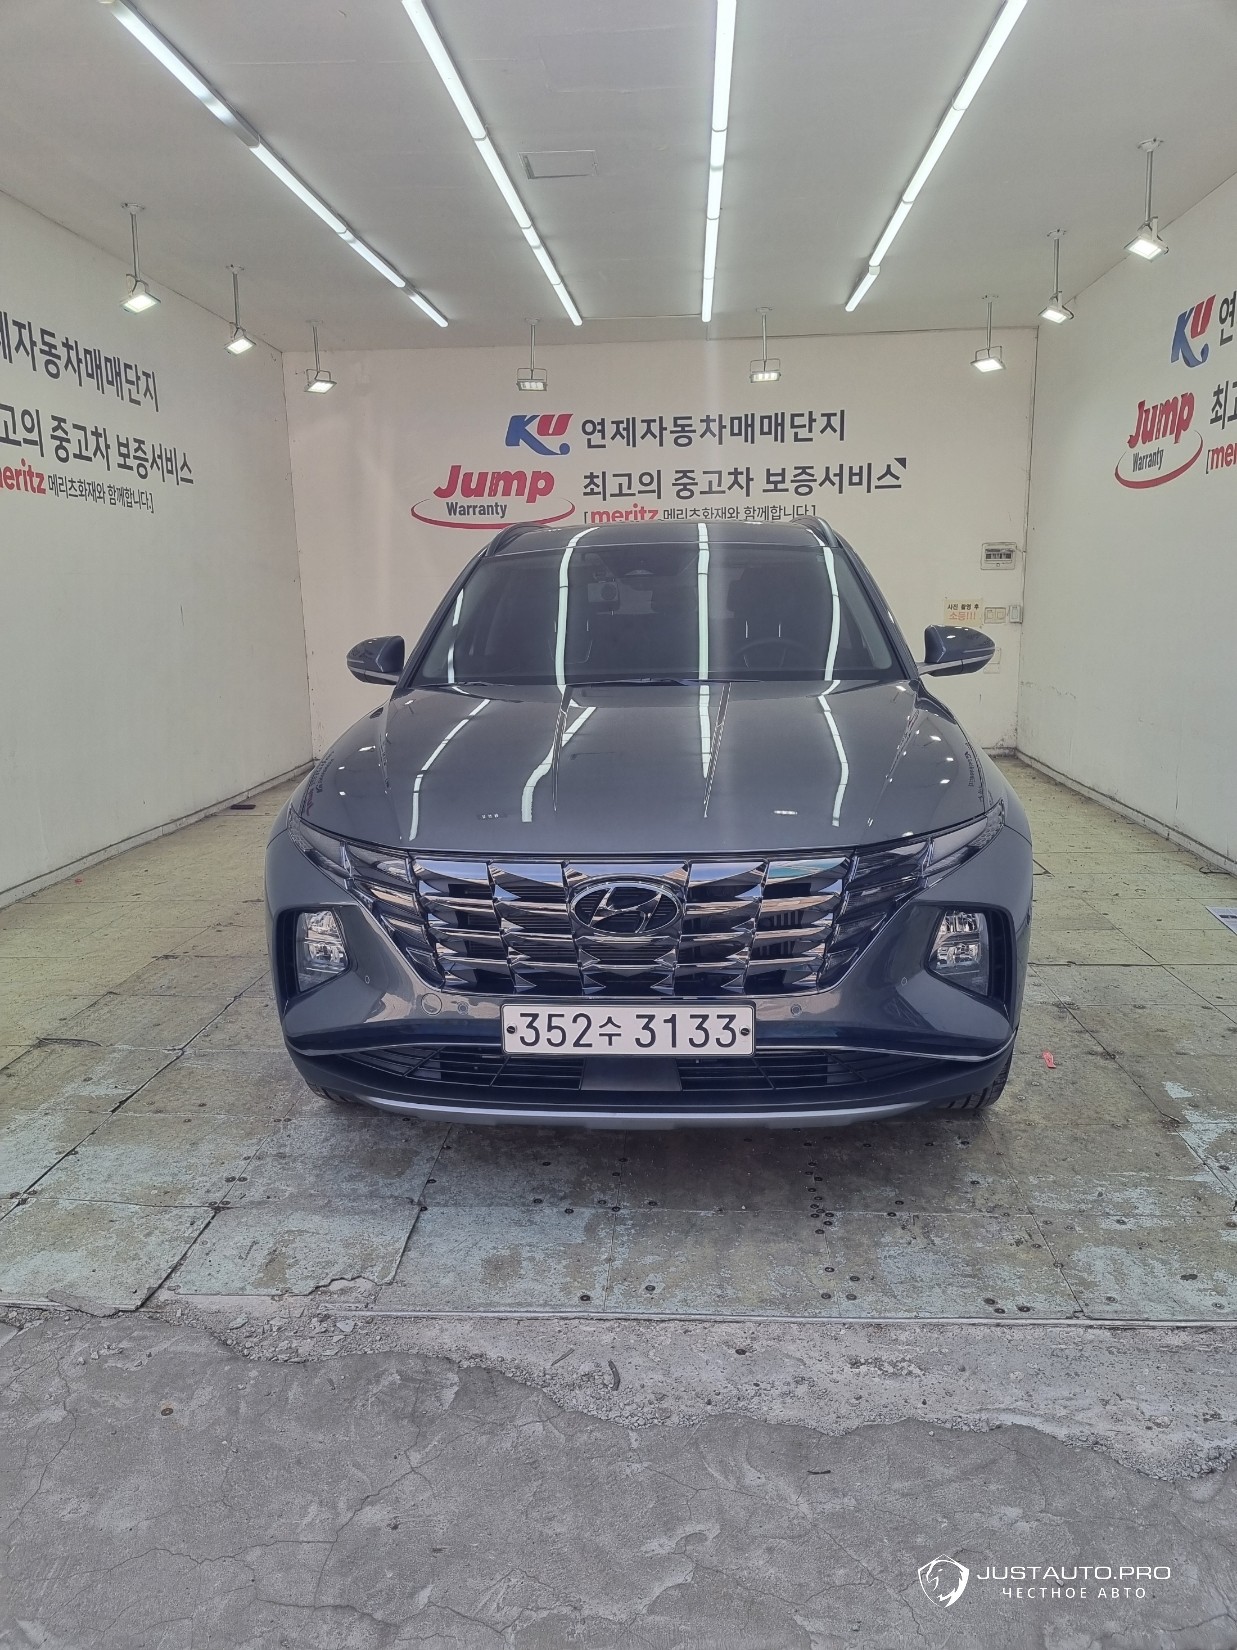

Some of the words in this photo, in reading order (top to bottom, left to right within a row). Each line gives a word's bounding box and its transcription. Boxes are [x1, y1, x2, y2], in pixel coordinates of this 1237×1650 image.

[581, 409, 846, 448] 연제자동차매매단지
[1127, 391, 1195, 449] Jump
[50, 414, 111, 472] 중고차
[116, 434, 194, 486] 보증서비스
[1132, 446, 1164, 473] Warranty
[0, 458, 46, 495] eritz
[47, 473, 106, 504] 메리츠화재와
[433, 465, 555, 503] Jump
[582, 469, 662, 502] 최고의
[671, 465, 754, 500] 중고차
[762, 463, 902, 497] 보증서비스
[445, 501, 508, 518] Warranty
[519, 1012, 622, 1048] 352수
[634, 1013, 737, 1048] 3133
